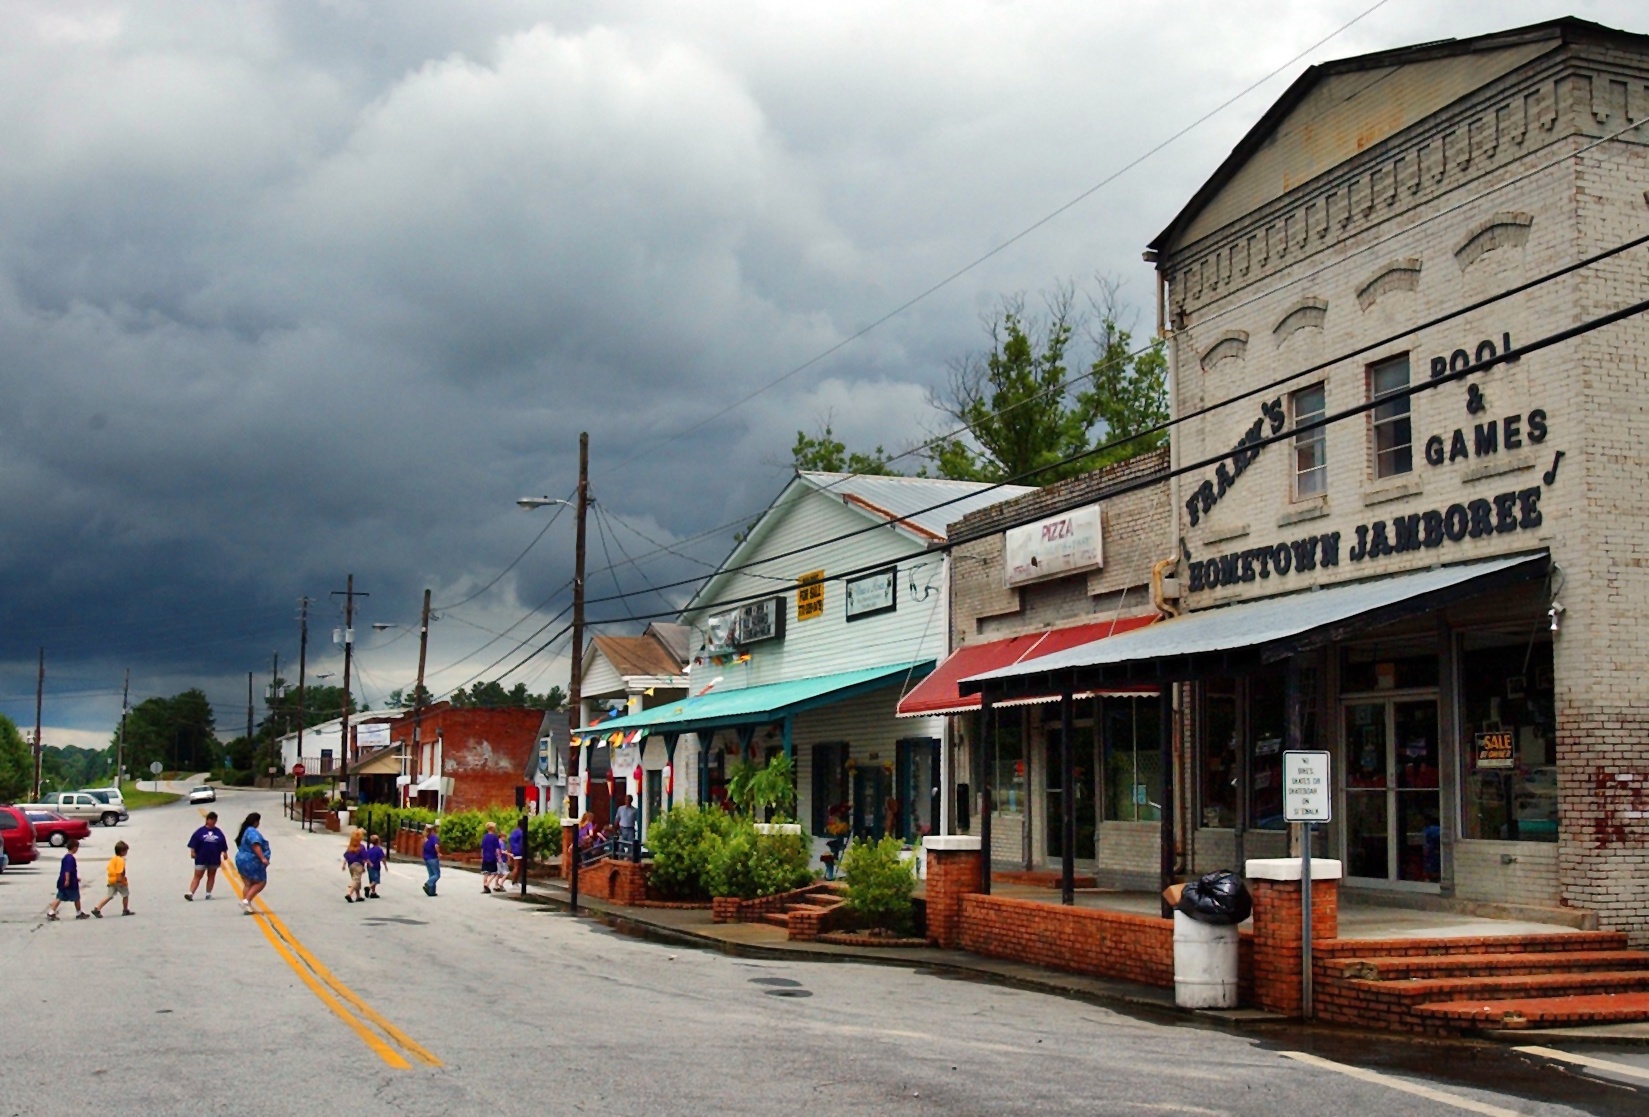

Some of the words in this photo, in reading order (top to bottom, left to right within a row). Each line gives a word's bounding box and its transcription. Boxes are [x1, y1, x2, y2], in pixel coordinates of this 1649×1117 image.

[1430, 332, 1521, 389] POOL
[1466, 383, 1486, 414] &
[1186, 397, 1285, 527] FRANK'S
[1425, 409, 1548, 466] GAMES
[1041, 518, 1074, 542] PIZZA
[1188, 531, 1341, 592] HOMETOWN
[1350, 486, 1543, 562] JAMBOREE
[1484, 735, 1512, 750] SALE
